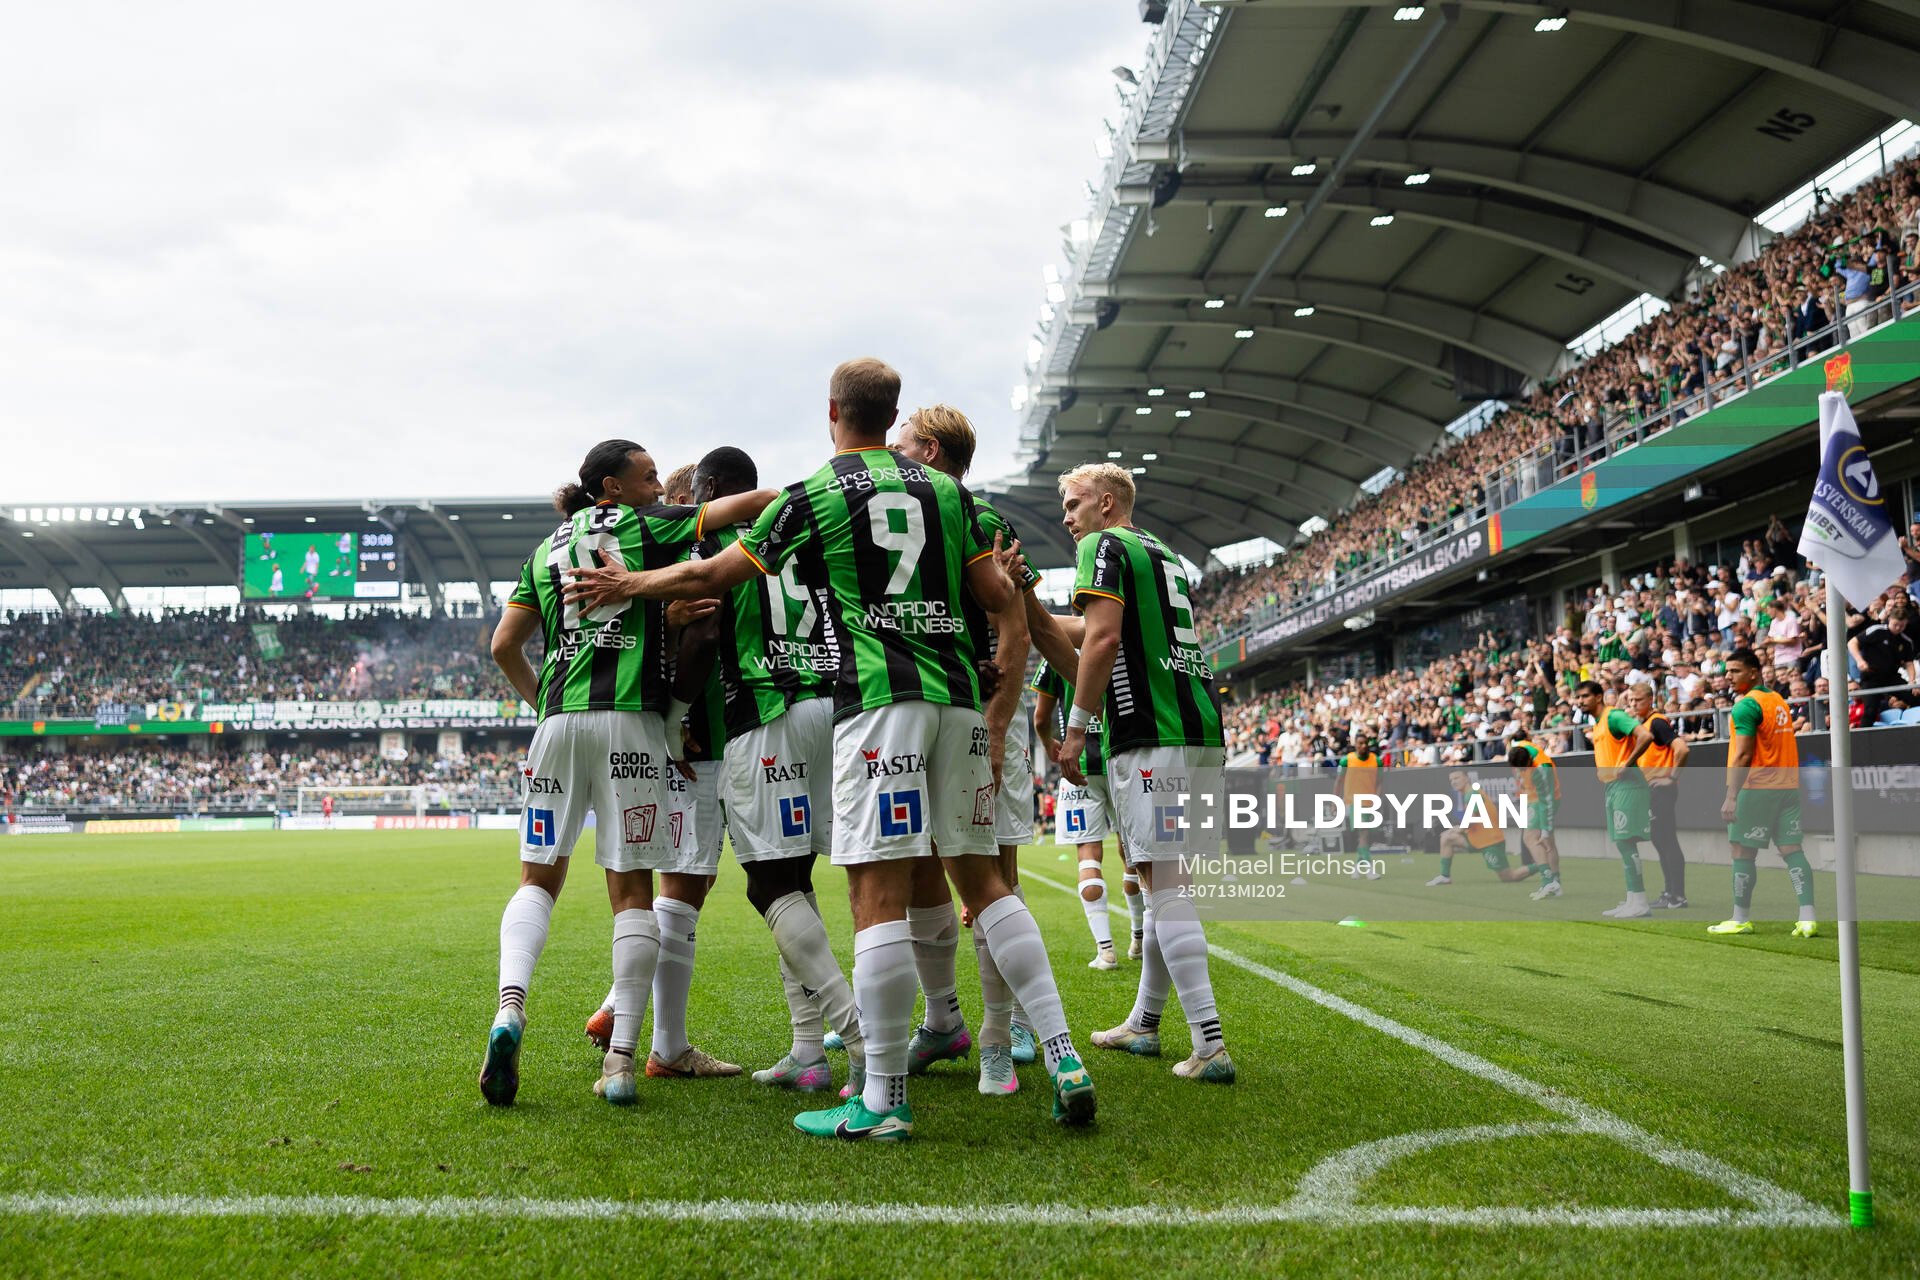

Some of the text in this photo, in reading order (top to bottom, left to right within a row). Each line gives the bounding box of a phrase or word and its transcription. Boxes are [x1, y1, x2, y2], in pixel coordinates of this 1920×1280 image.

[1756, 107, 1816, 142] N5
[1554, 272, 1595, 296] L5
[826, 466, 933, 493] ergoseat
[775, 504, 793, 532] Group
[867, 491, 927, 595] 9
[1094, 569, 1104, 587] Care
[869, 601, 946, 618] NORDIC
[1161, 559, 1199, 644] 5
[854, 614, 965, 634] WELLNESS
[768, 640, 828, 658] NORDIC
[1170, 644, 1205, 663] NORD
[753, 654, 836, 671] WELLNES
[610, 752, 650, 766] GOOD
[866, 753, 927, 780] RASTA
[610, 766, 660, 780] ADVICE
[764, 762, 808, 784] RAST
